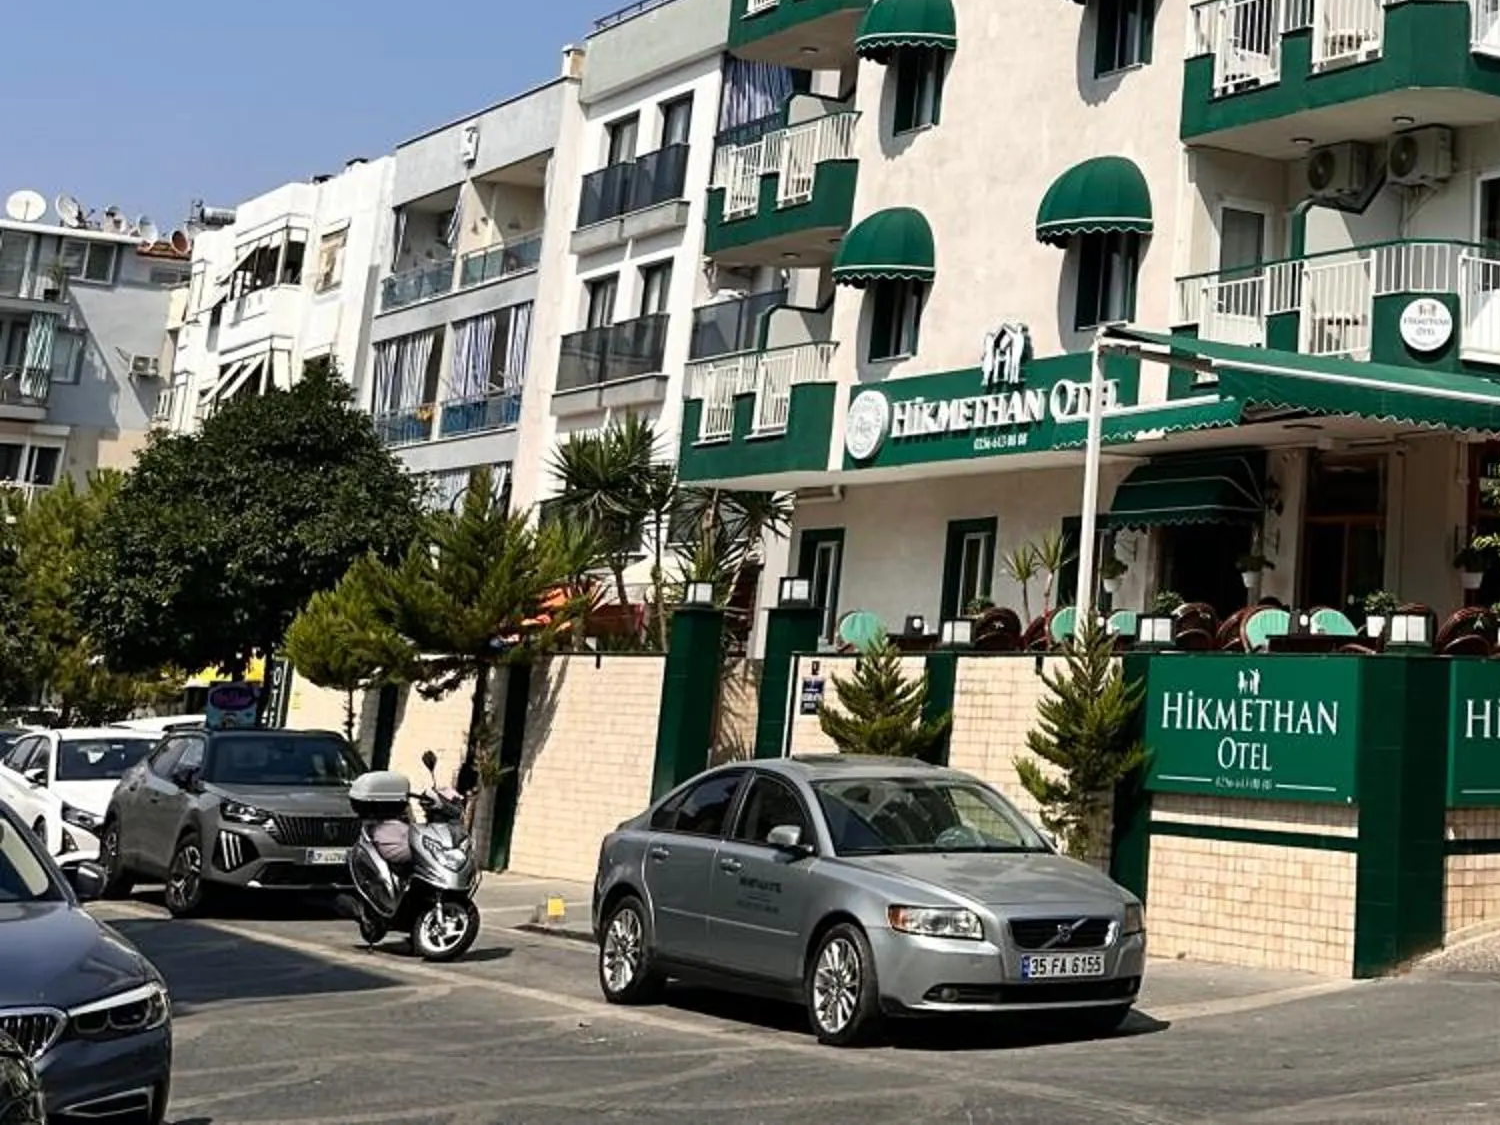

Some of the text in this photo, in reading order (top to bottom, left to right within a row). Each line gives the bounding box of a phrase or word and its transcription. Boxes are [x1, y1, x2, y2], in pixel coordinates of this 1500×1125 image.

[1161, 690, 1338, 735] HİKMETHAN
[1217, 736, 1272, 771] OTEL
[1031, 958, 1047, 975] 35
[1051, 957, 1067, 974] FA
